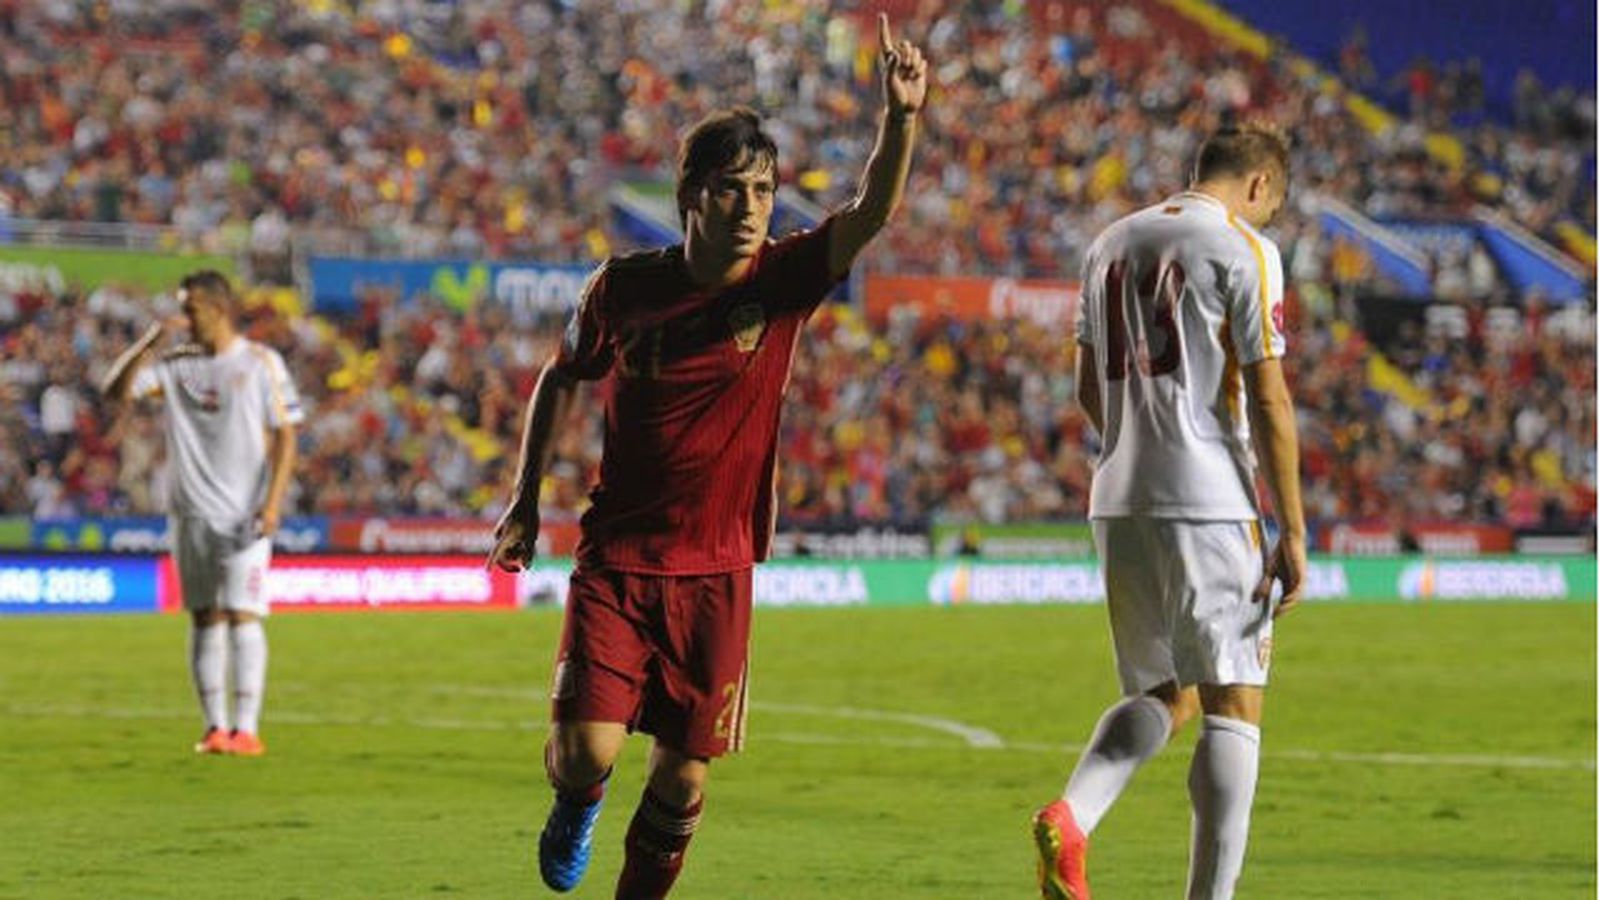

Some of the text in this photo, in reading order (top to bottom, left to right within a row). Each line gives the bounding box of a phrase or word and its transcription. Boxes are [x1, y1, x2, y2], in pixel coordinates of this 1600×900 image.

[1105, 256, 1186, 380] 13
[45, 567, 115, 603] 2016
[364, 567, 491, 606] QUALIFIERS
